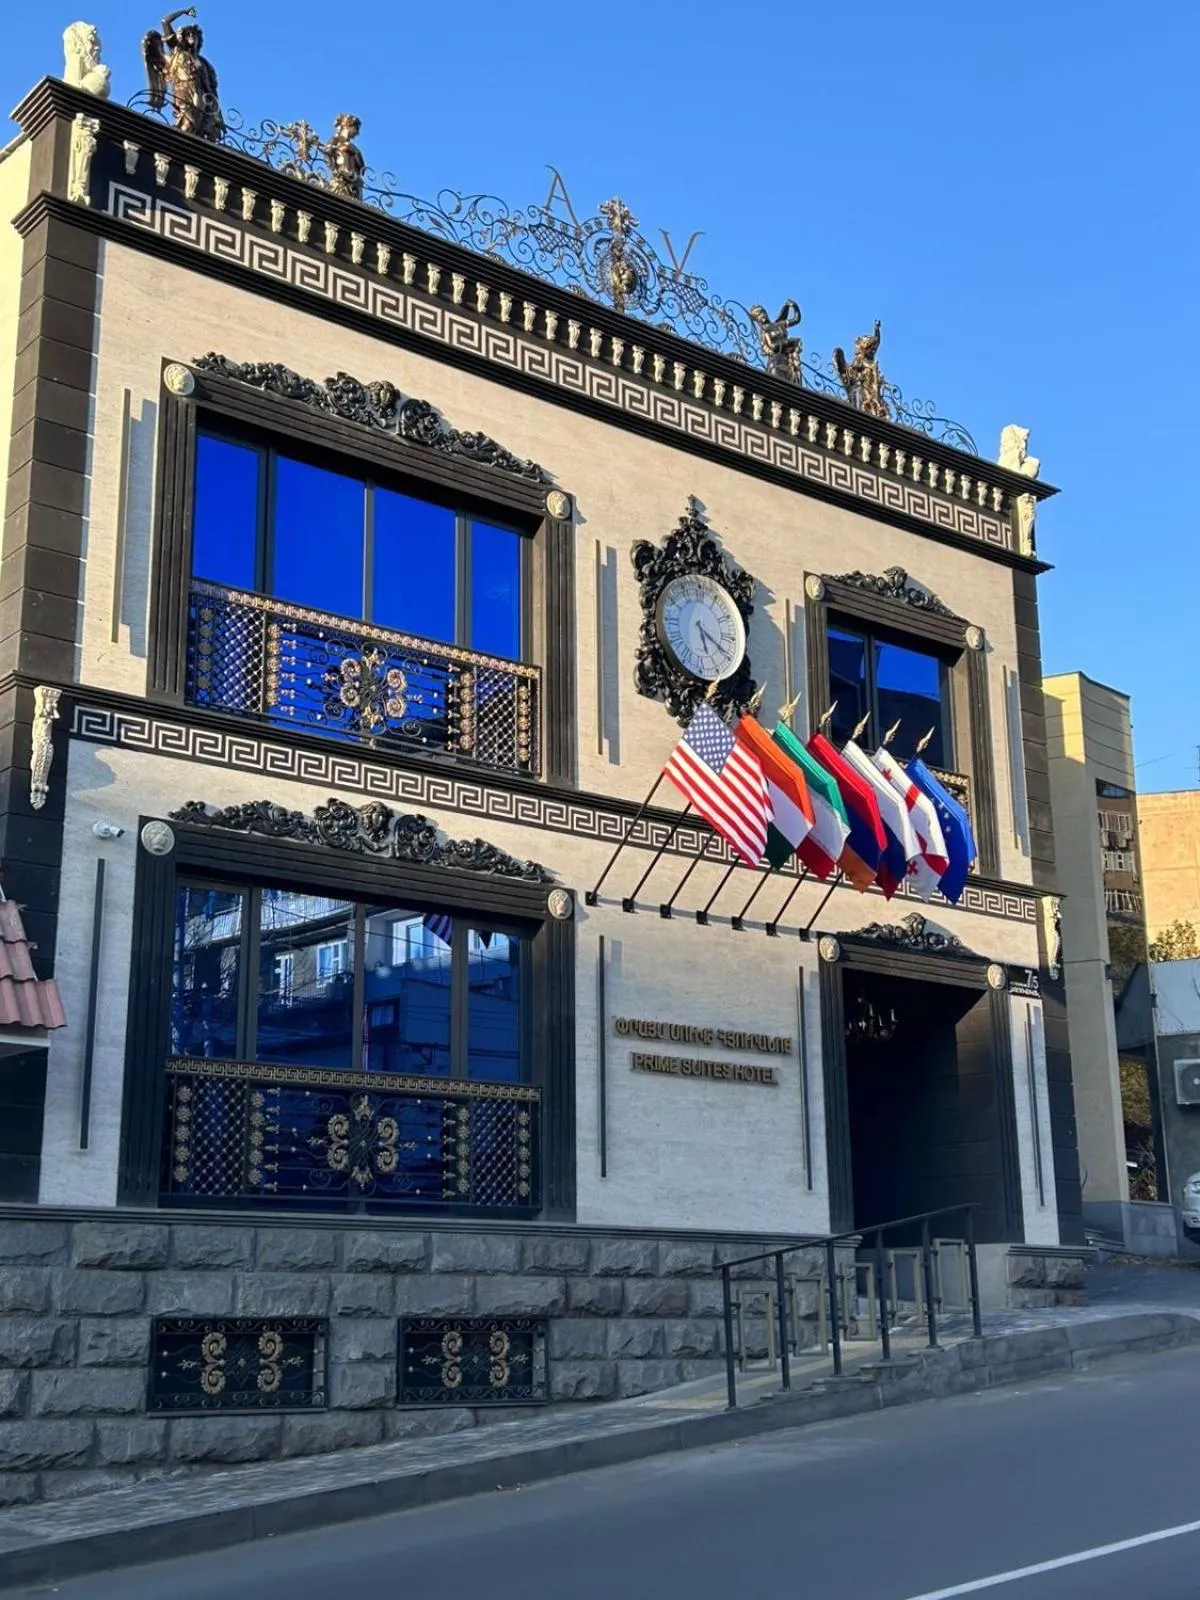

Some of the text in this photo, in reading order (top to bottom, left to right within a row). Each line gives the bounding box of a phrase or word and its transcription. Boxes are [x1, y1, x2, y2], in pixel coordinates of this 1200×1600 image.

[632, 1053, 779, 1085] PRIME SUITES HOTEL
